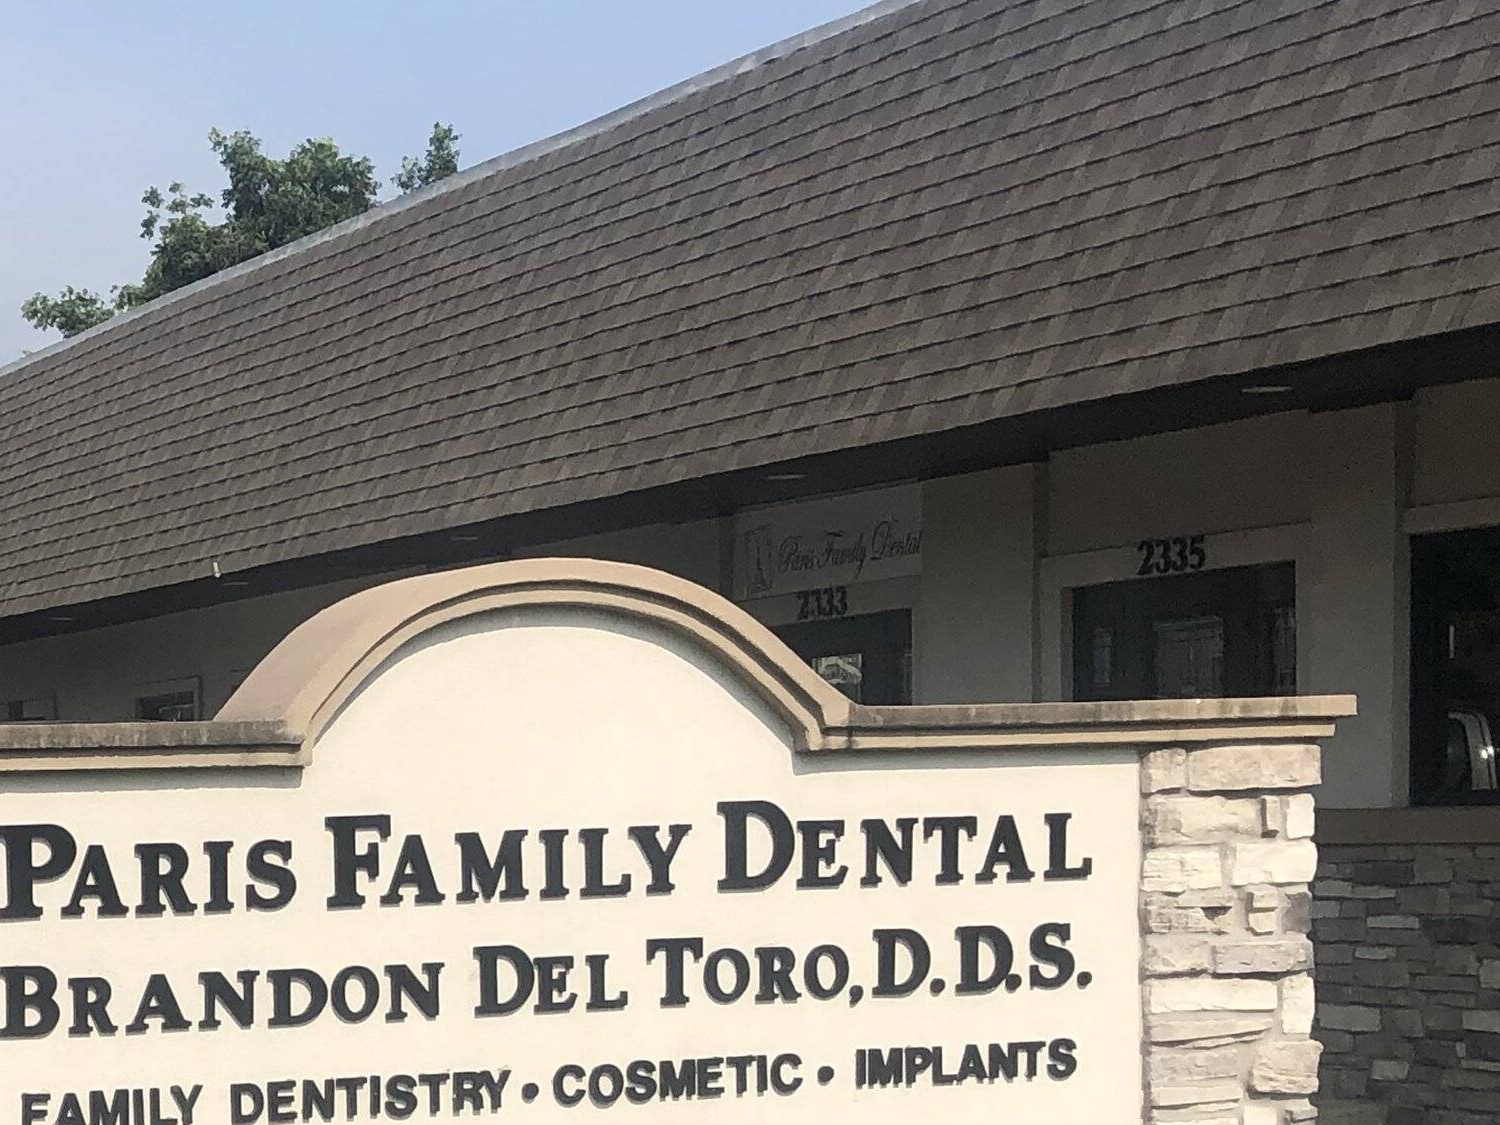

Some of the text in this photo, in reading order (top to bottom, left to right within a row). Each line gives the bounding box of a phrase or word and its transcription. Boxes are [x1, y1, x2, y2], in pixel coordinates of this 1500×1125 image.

[818, 529, 867, 580] Family
[870, 515, 923, 561] Dental
[1137, 534, 1205, 576] 2335
[553, 1053, 803, 1109] COSMETIC
[855, 1037, 1078, 1090] IMPLANTS
